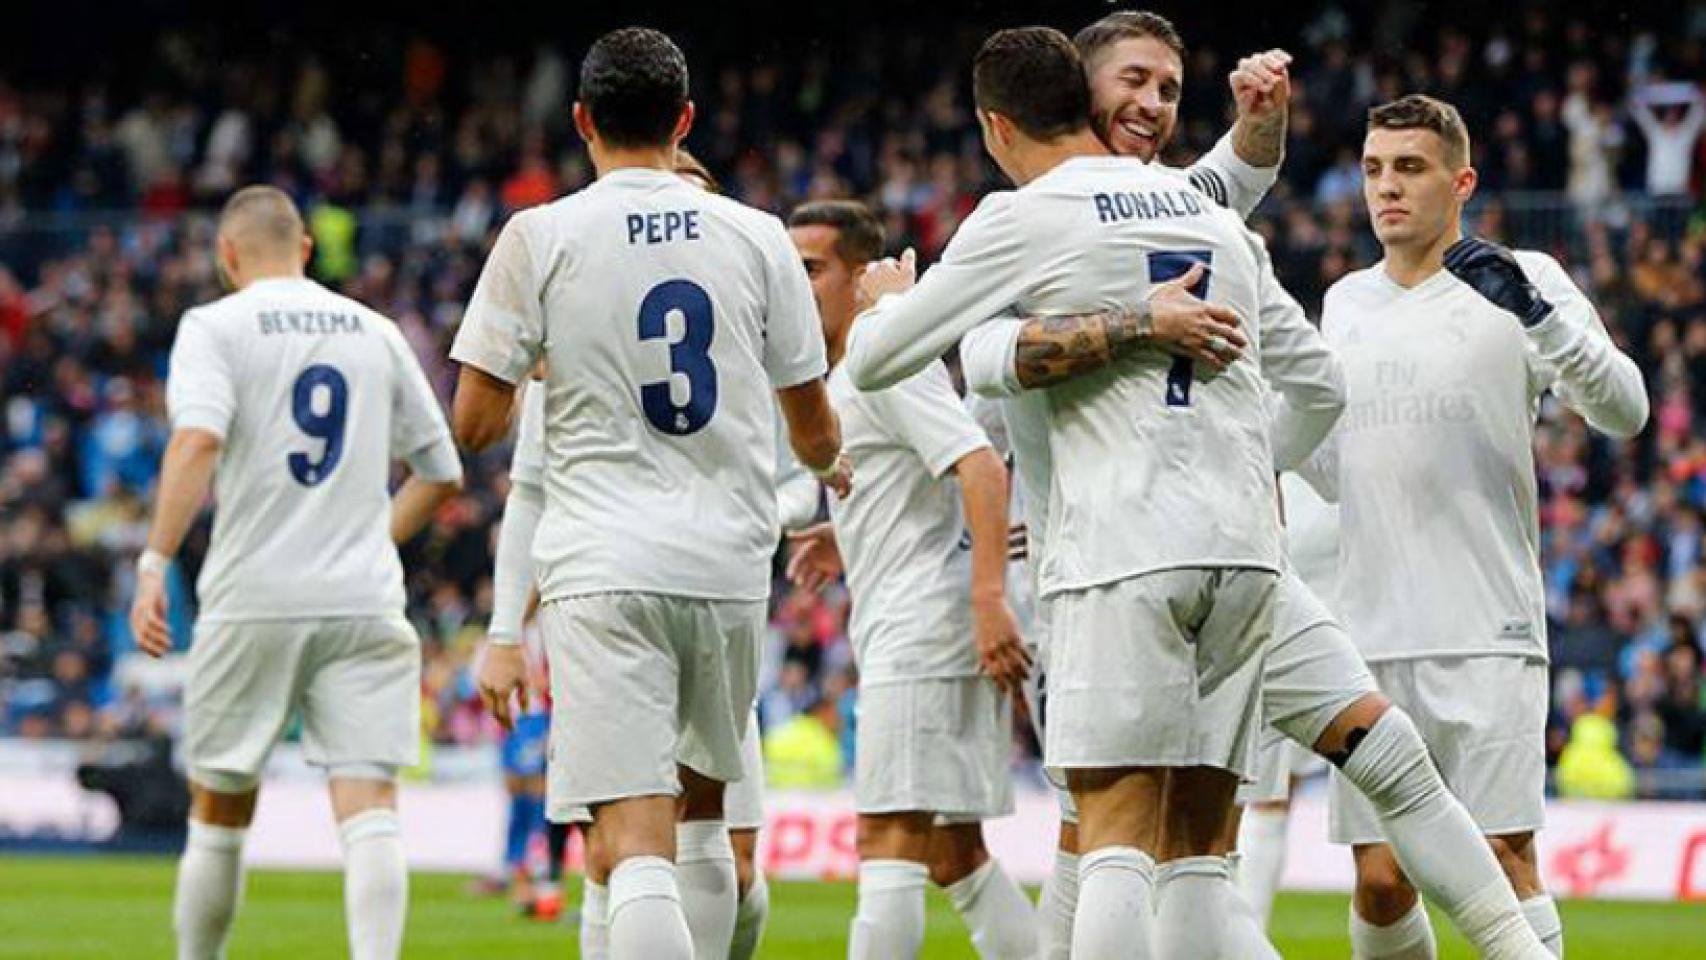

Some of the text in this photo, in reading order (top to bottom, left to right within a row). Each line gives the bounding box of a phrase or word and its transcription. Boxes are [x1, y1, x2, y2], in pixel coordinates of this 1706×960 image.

[1093, 190, 1206, 222] RONALD
[627, 211, 701, 243] PEPE
[259, 311, 364, 334] BENZEMA
[638, 279, 718, 437] 3
[288, 364, 348, 486] 9
[1346, 389, 1476, 430] mirates
